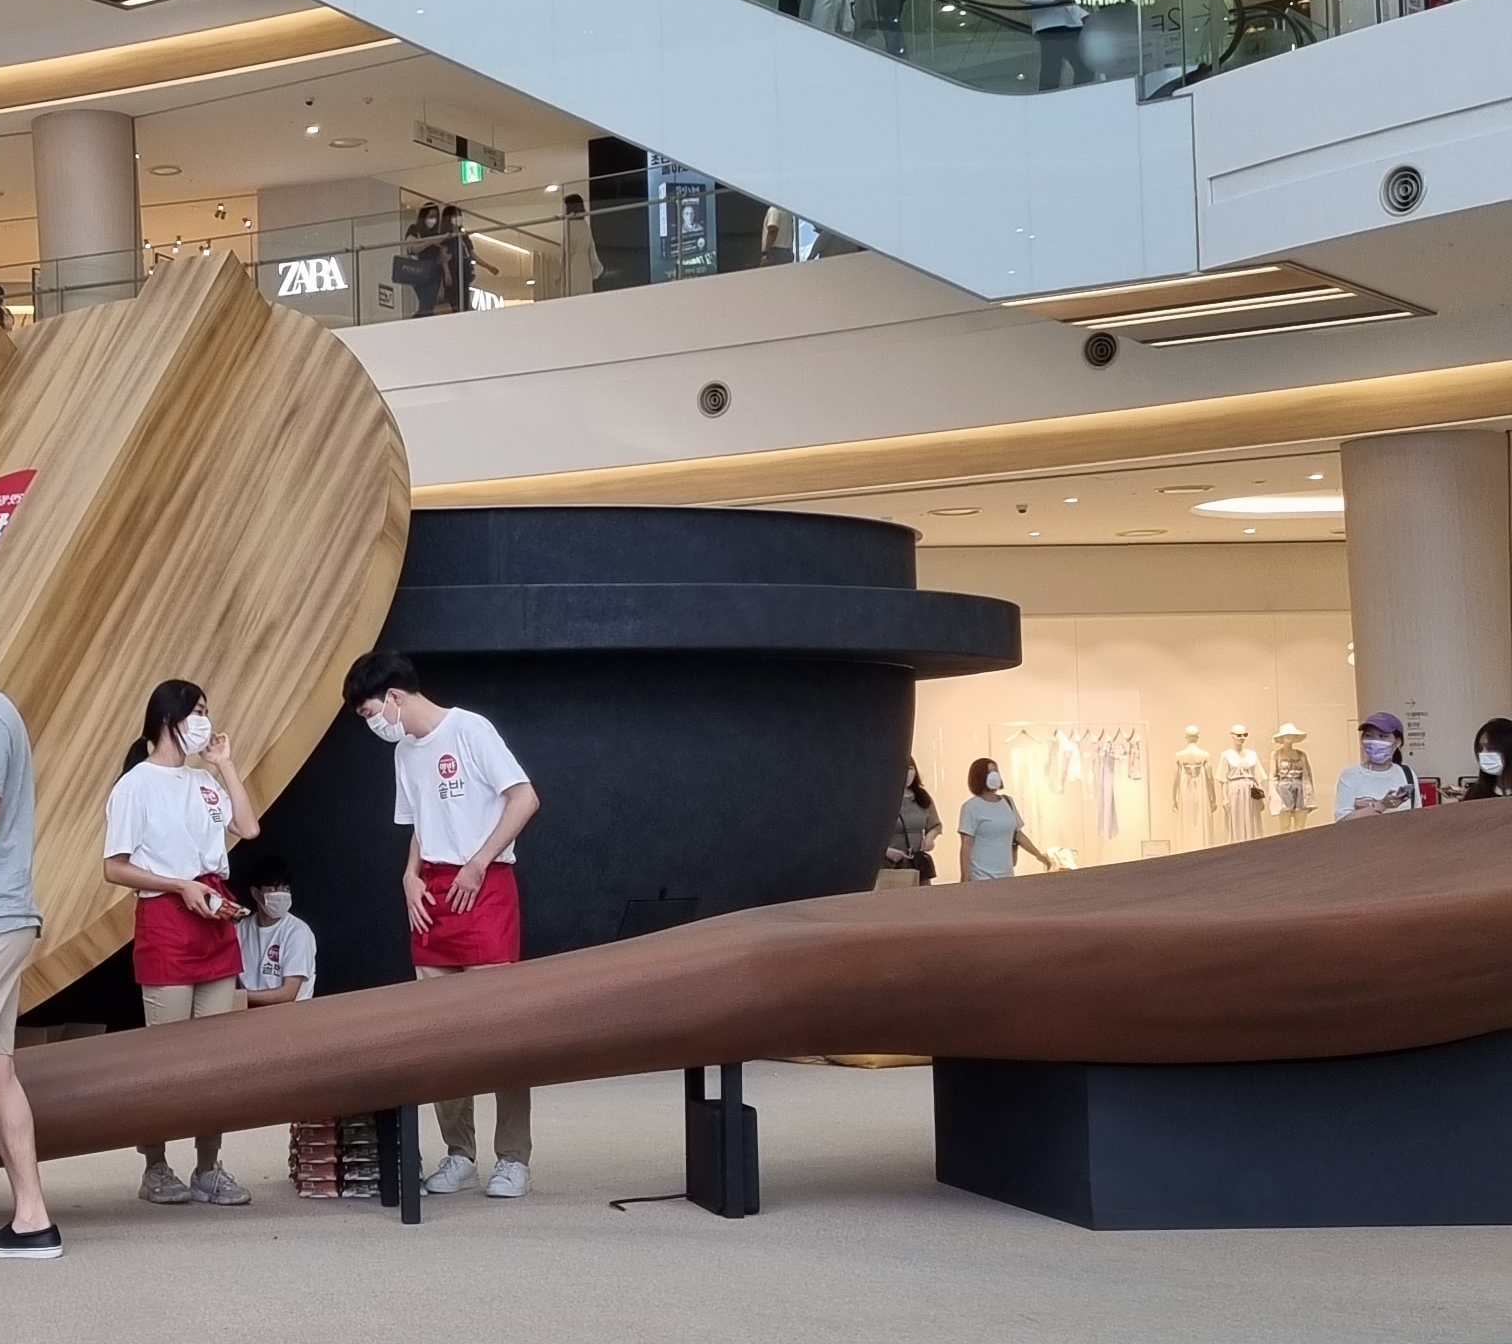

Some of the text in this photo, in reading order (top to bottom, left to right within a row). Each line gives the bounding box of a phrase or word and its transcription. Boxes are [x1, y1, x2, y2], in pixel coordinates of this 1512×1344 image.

[278, 256, 349, 296] ZARA
[438, 778, 465, 800] 솥반
[208, 806, 223, 823] 솥
